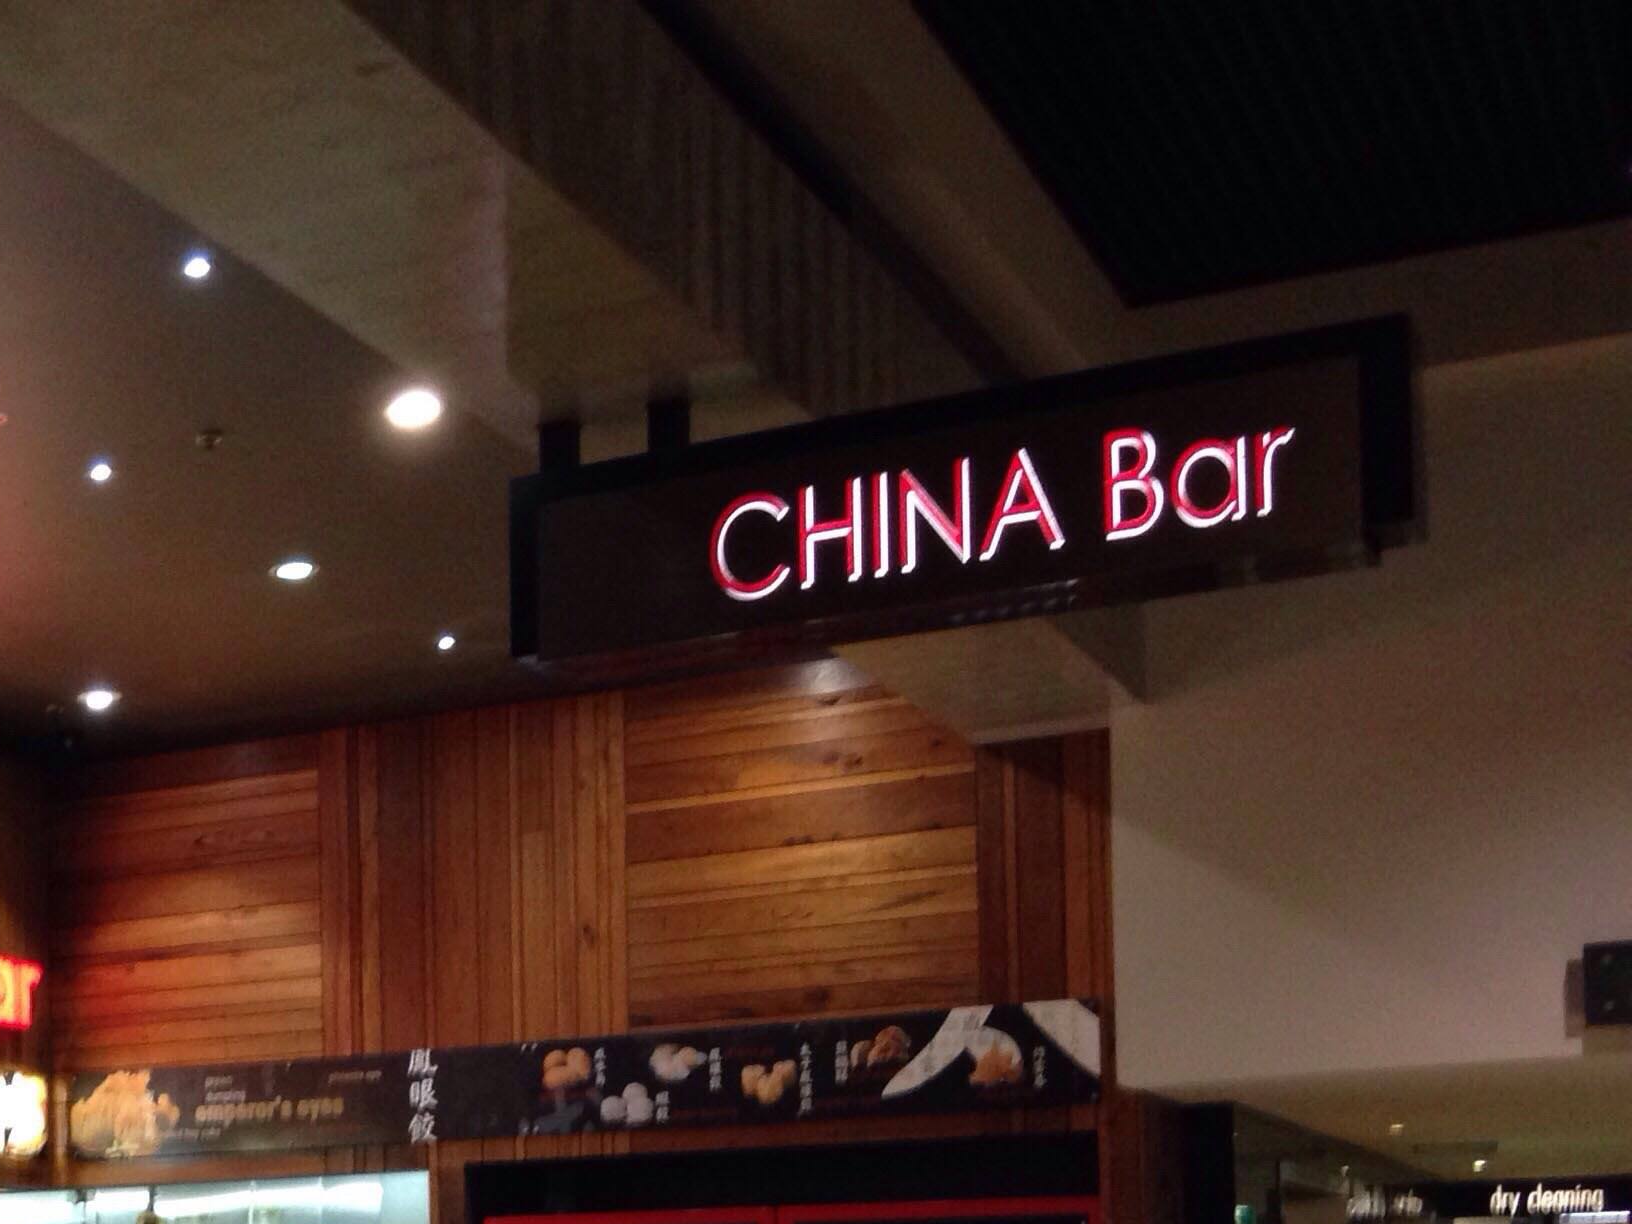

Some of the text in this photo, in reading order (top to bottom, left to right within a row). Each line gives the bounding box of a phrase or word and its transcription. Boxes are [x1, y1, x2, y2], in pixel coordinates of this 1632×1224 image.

[709, 426, 1295, 601] CHINA Bar
[195, 1095, 293, 1127] emperor's
[1490, 1182, 1604, 1217] dry cleaning
